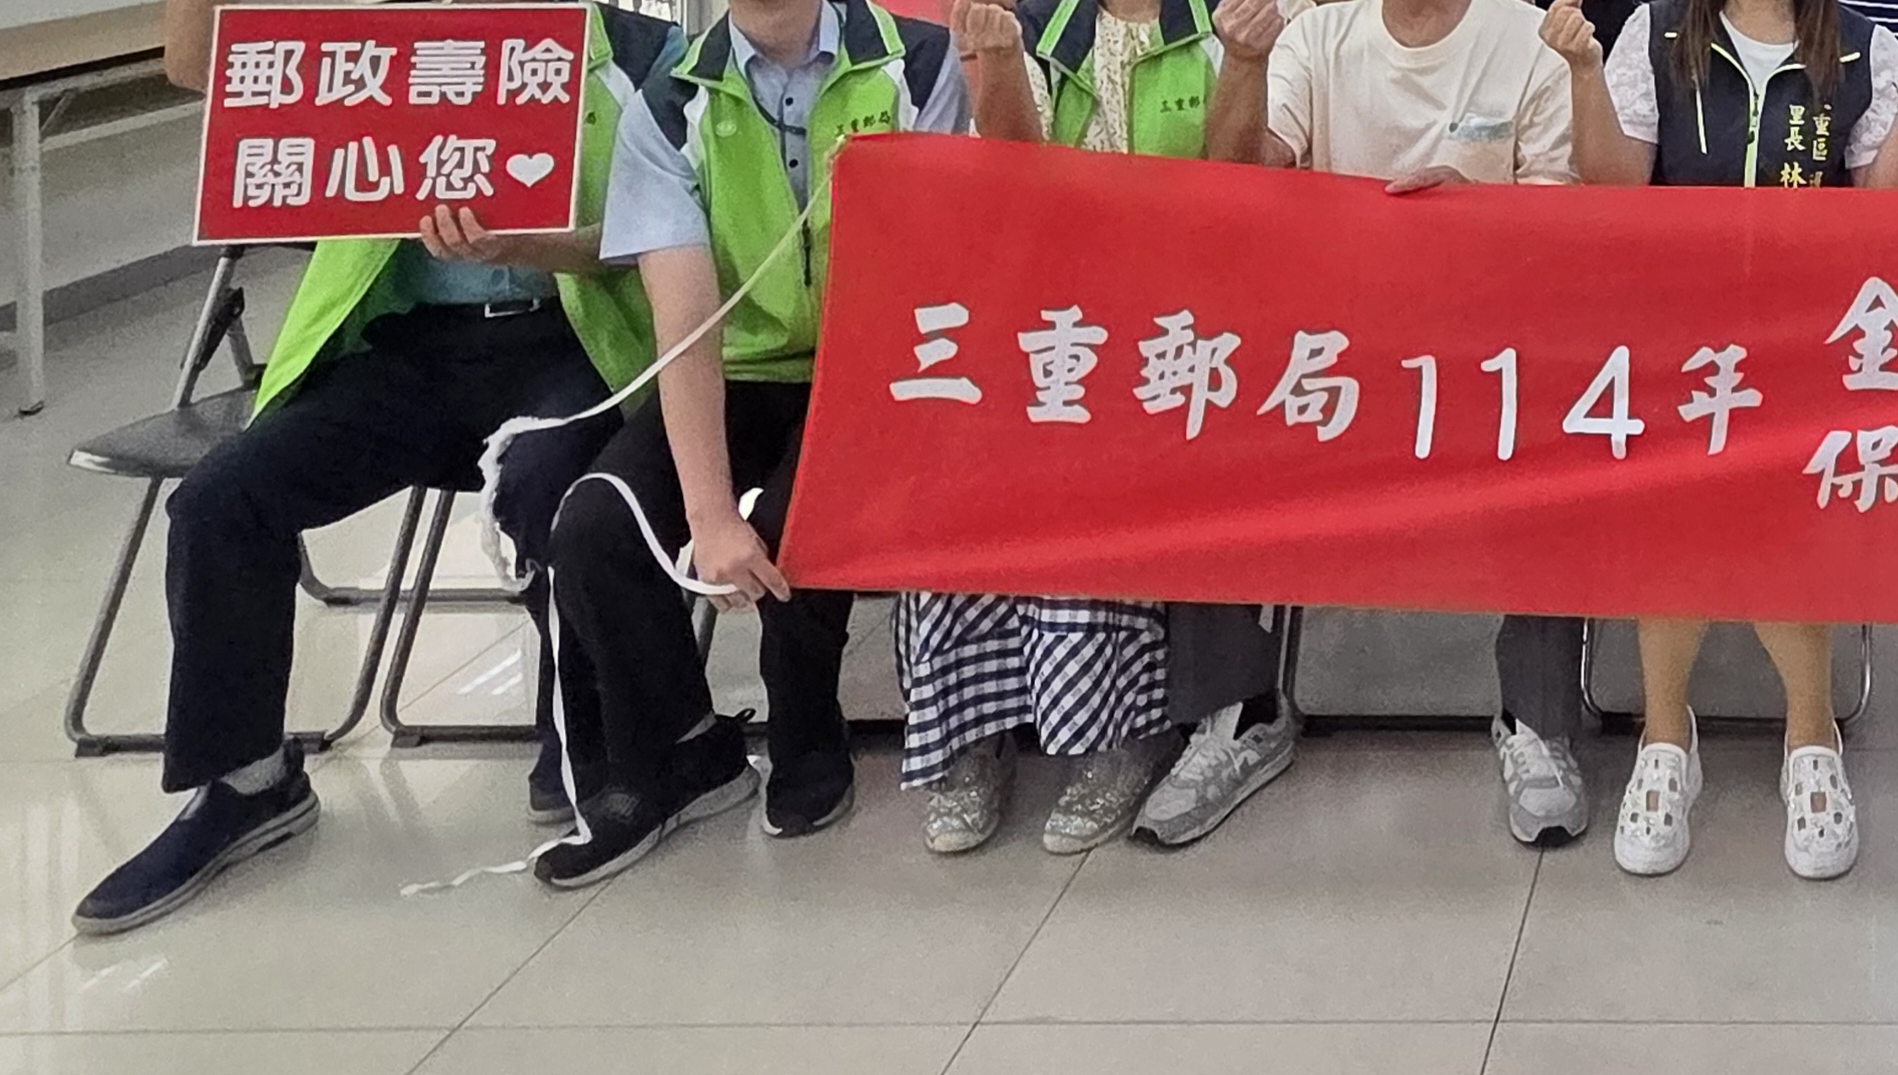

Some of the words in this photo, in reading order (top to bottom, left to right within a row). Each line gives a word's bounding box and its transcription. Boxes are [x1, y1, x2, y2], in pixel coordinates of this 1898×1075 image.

[222, 38, 574, 109] 郵政壽險
[1160, 95, 1206, 113] 三重郵
[1812, 103, 1832, 161] 重區
[232, 134, 496, 209] 關心您
